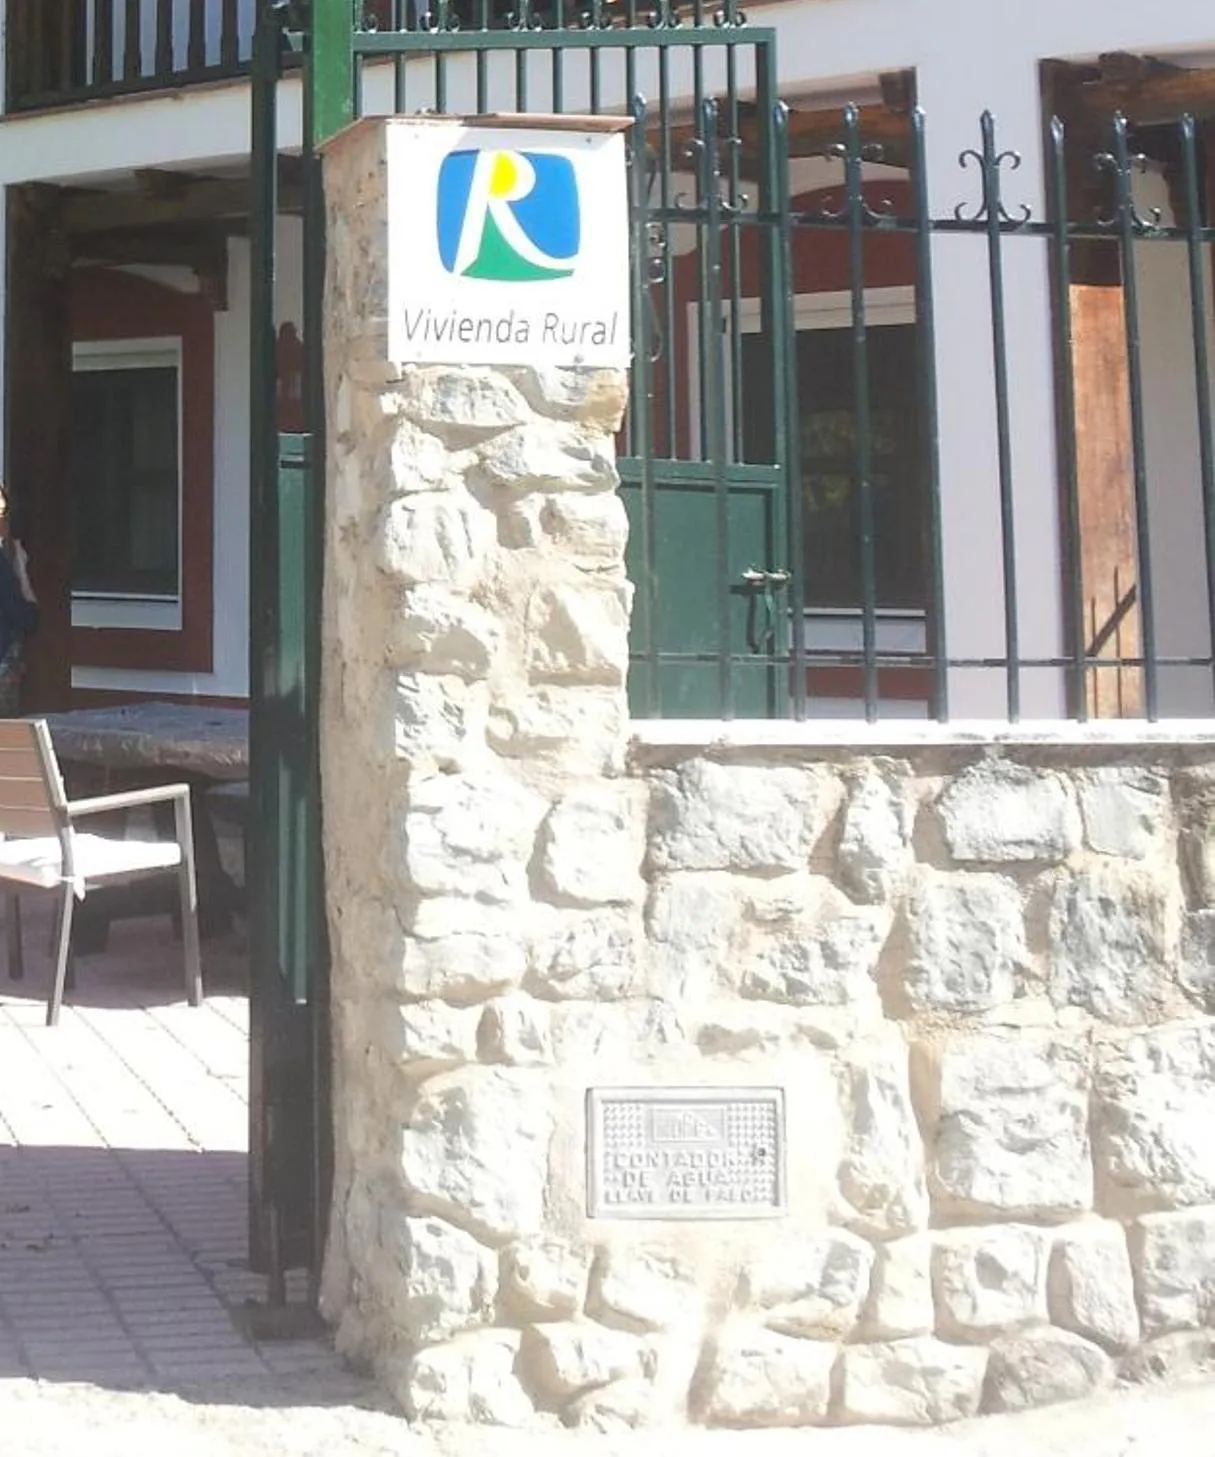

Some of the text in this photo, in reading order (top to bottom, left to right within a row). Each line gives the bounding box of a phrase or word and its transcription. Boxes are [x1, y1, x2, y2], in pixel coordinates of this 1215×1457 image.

[403, 308, 618, 346] Vivienda Rural
[622, 1169, 732, 1188] DE AGUA
